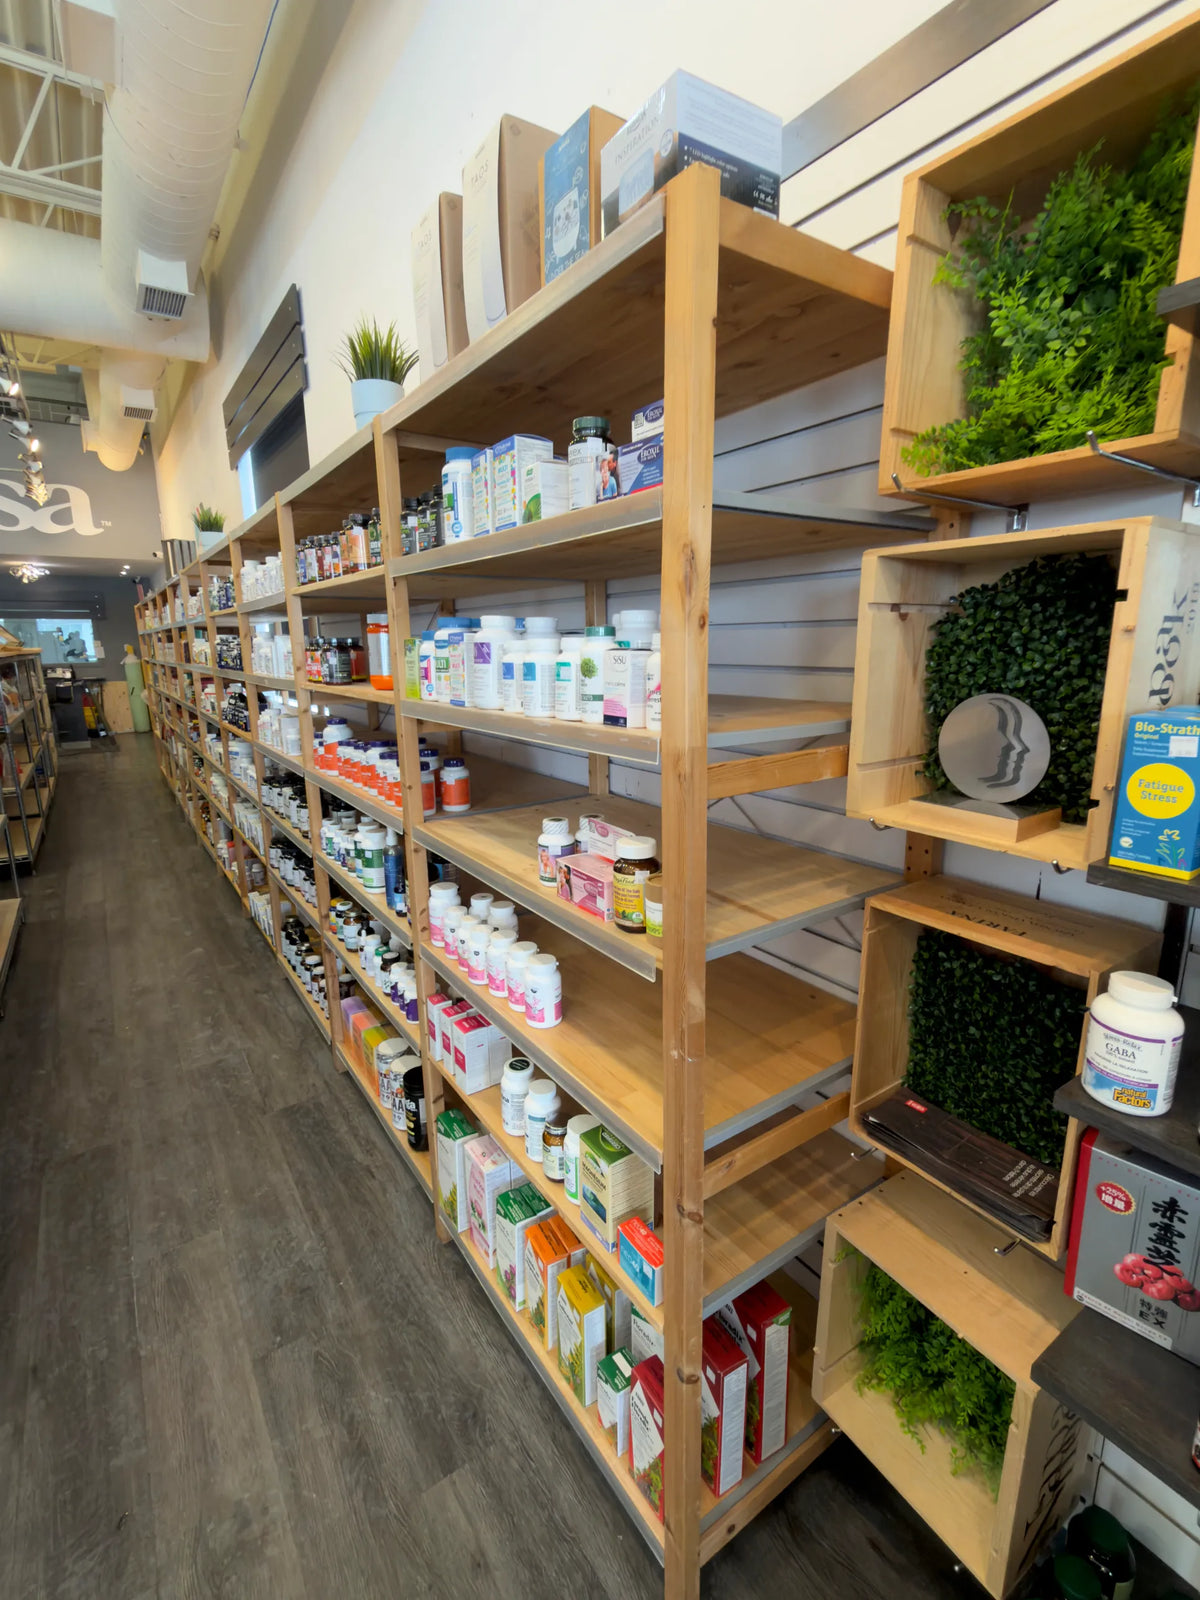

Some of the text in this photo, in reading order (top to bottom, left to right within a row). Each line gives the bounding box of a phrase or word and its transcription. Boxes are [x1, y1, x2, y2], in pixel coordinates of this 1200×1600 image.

[1135, 721, 1200, 736] Bio-Strath
[1138, 778, 1184, 793] Fatigue
[1140, 790, 1178, 804] Stress
[1105, 1042, 1137, 1060] GABA
[1113, 1089, 1151, 1108] Factors
[1121, 1087, 1147, 1099] natural
[1101, 1185, 1127, 1201] +25%
